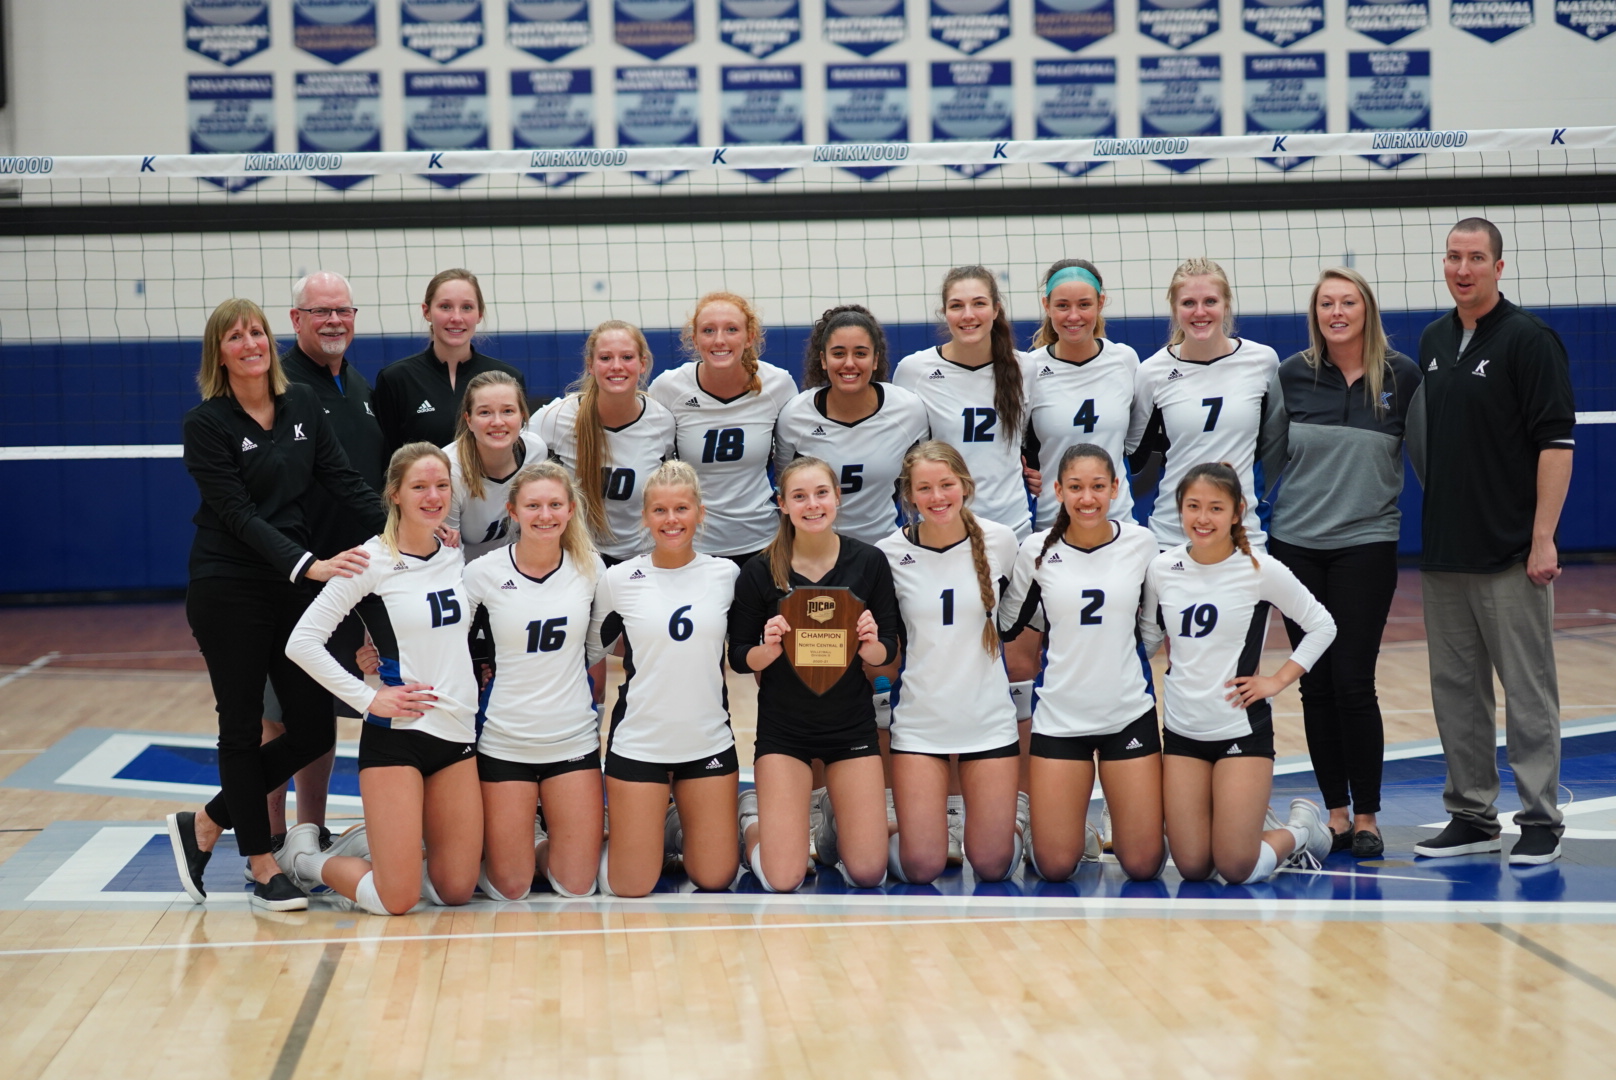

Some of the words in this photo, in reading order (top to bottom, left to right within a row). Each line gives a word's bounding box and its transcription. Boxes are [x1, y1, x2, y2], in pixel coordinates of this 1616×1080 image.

[1350, 4, 1428, 17] NATIONAL
[1452, 1, 1531, 14] NATIONAL
[1452, 13, 1532, 28] QUALIFIER
[1272, 136, 1288, 152] K
[1372, 131, 1467, 149] KIRKWOOD
[1550, 128, 1567, 145] K
[814, 144, 909, 161] KIRKWOOD
[993, 142, 1008, 158] K
[1093, 138, 1189, 156] KIRKWOOD
[141, 156, 156, 172] K
[245, 154, 342, 171] KIRKWOOD
[428, 153, 444, 169] K
[531, 150, 627, 167] KIRKWOOD
[712, 148, 727, 164] K
[0, 157, 53, 174] WOOD
[1475, 359, 1490, 374] K
[1073, 399, 1099, 433] 4
[1202, 397, 1223, 432] 7
[294, 423, 305, 438] K
[962, 407, 997, 442] 12
[703, 427, 745, 463] 18
[600, 467, 636, 501] 10
[841, 464, 864, 494] 5
[426, 588, 462, 628] 15
[808, 601, 834, 613] NJCAA
[940, 588, 954, 626] 1
[1080, 588, 1105, 625] 2
[668, 605, 694, 641] 6
[1178, 603, 1218, 638] 19
[525, 616, 568, 653] 16
